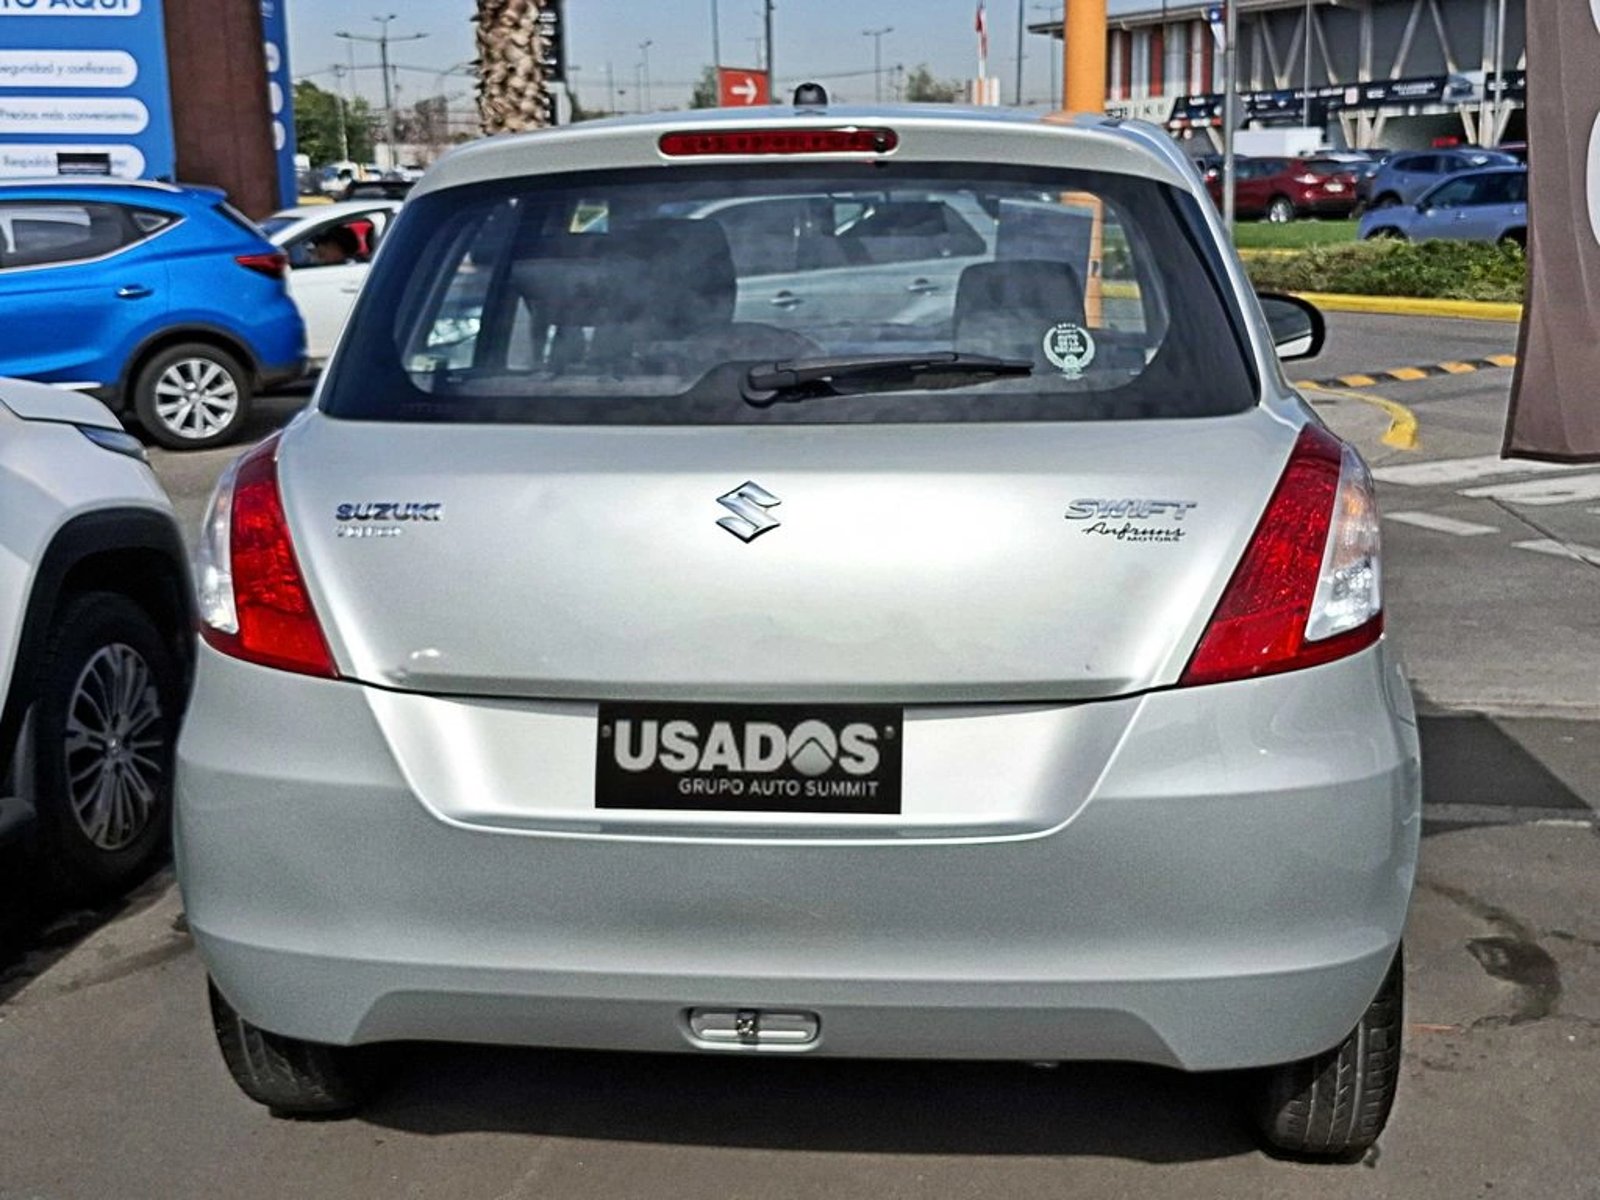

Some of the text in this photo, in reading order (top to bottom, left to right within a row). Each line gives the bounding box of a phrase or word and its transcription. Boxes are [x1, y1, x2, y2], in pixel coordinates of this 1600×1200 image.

[336, 502, 442, 521] SUZUKI
[1064, 498, 1198, 521] SWIFT
[614, 718, 880, 776] USADOS
[678, 778, 879, 797] GRUPO AUTO SUMMIT
